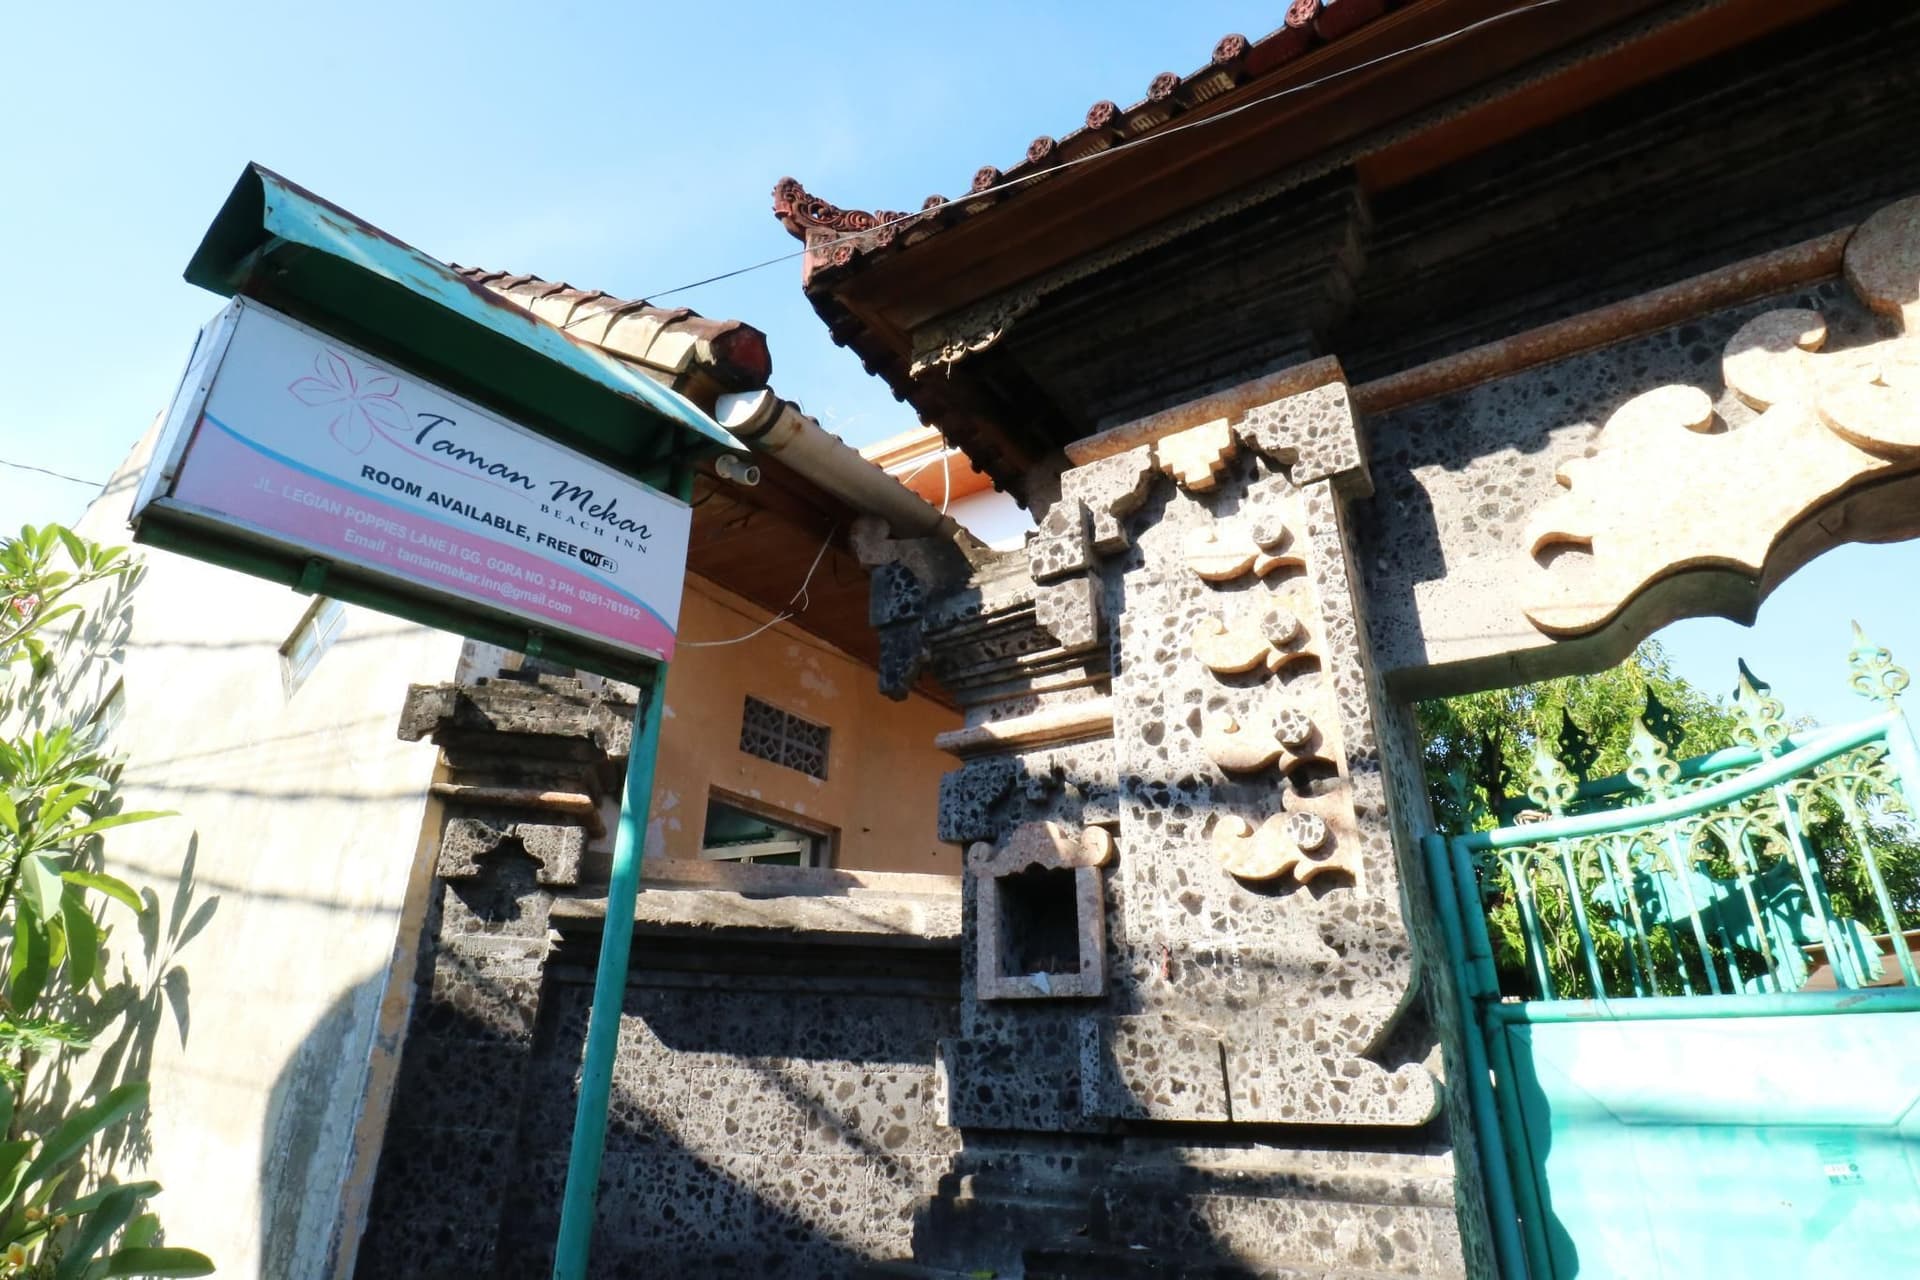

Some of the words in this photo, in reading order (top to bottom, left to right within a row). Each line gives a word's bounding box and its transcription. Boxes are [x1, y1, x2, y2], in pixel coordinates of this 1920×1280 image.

[360, 464, 423, 499] ROOM
[426, 491, 531, 542] AVAILABLE,
[536, 532, 578, 558] FREE
[415, 412, 536, 490] Taman
[550, 480, 652, 540] Mekar
[281, 485, 342, 515] LEGIAN
[344, 505, 408, 538] POPPIES
[409, 529, 447, 553] LANE
[487, 557, 523, 580] GORA
[344, 528, 385, 553] Email
[540, 503, 604, 536] BEACH
[614, 535, 647, 554] INN
